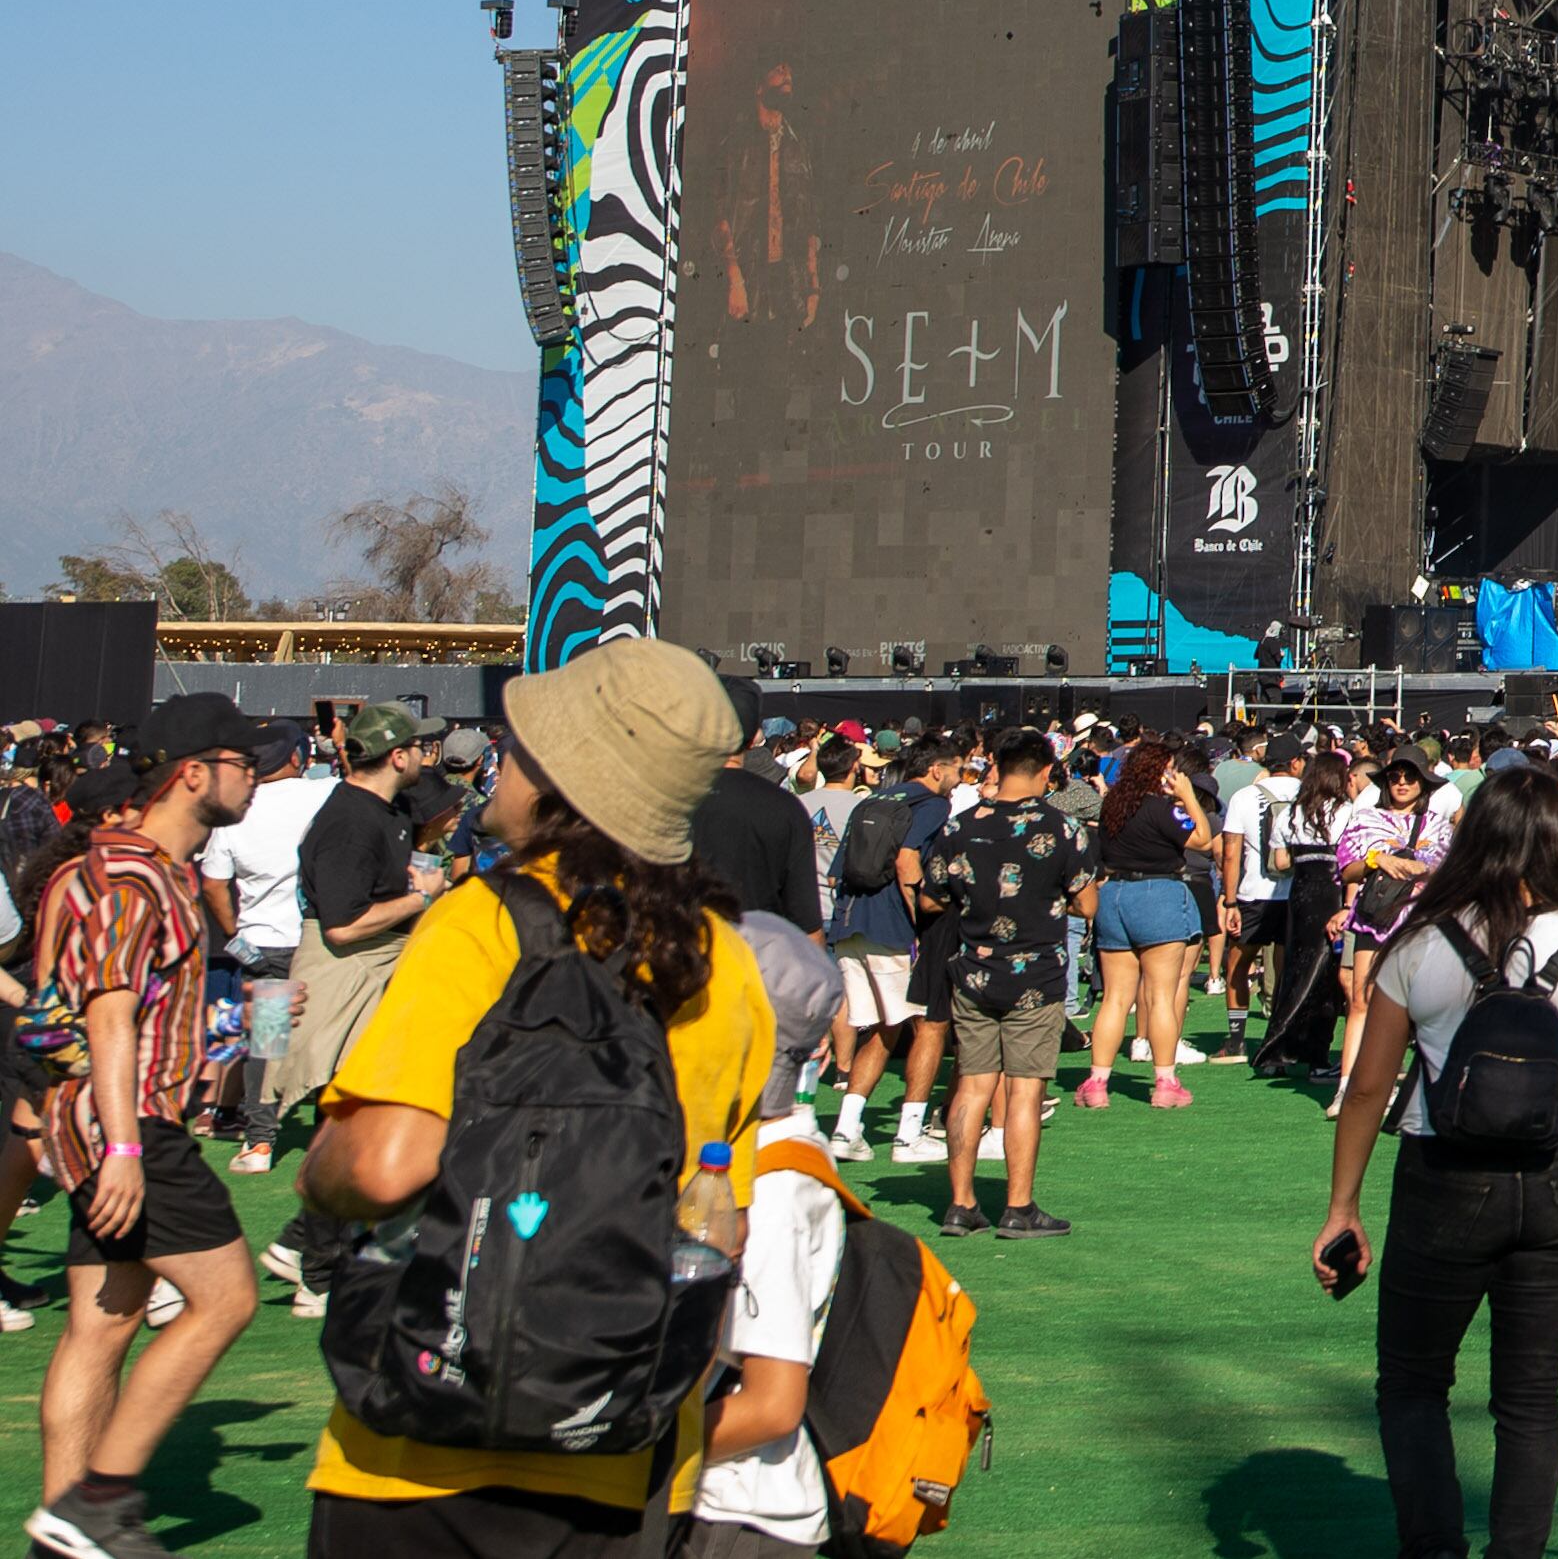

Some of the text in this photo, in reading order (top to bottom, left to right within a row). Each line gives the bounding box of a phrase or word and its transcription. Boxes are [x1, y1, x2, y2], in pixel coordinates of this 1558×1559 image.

[928, 126, 948, 155] de
[952, 120, 995, 153] abril
[852, 156, 1050, 225] Santiago de Chile
[967, 212, 1023, 265] Arena
[902, 441, 993, 460] TOUR
[1194, 538, 1263, 553] Banco de Chile
